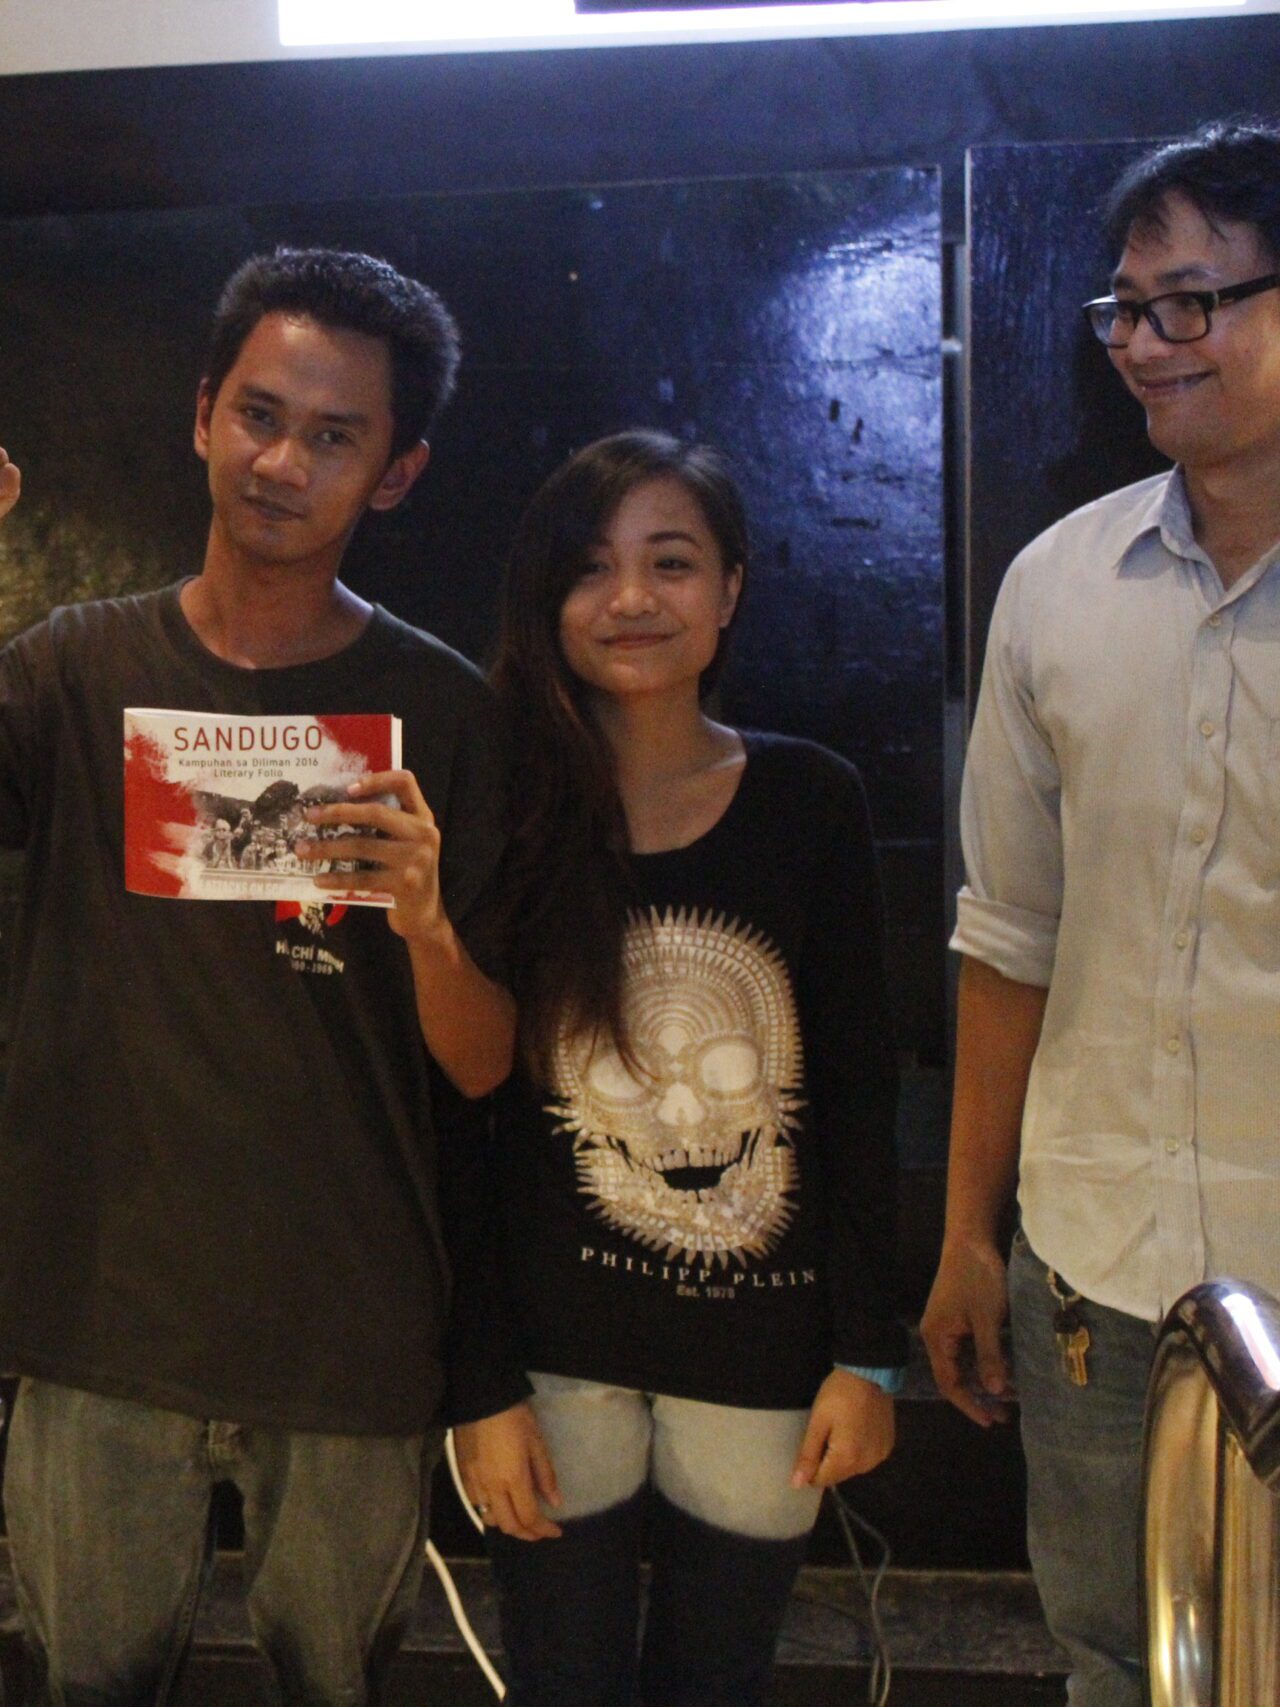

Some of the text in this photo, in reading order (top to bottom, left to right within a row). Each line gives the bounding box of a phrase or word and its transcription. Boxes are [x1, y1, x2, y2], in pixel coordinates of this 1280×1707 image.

[174, 725, 323, 752] SANDUGO
[178, 758, 232, 768] Kampuhan
[252, 758, 291, 767] Diliman
[295, 757, 319, 767] 2016
[214, 768, 284, 779] Literary Folio
[580, 1246, 817, 1288] PHILIPP PLEIN
[676, 1284, 700, 1298] Est.
